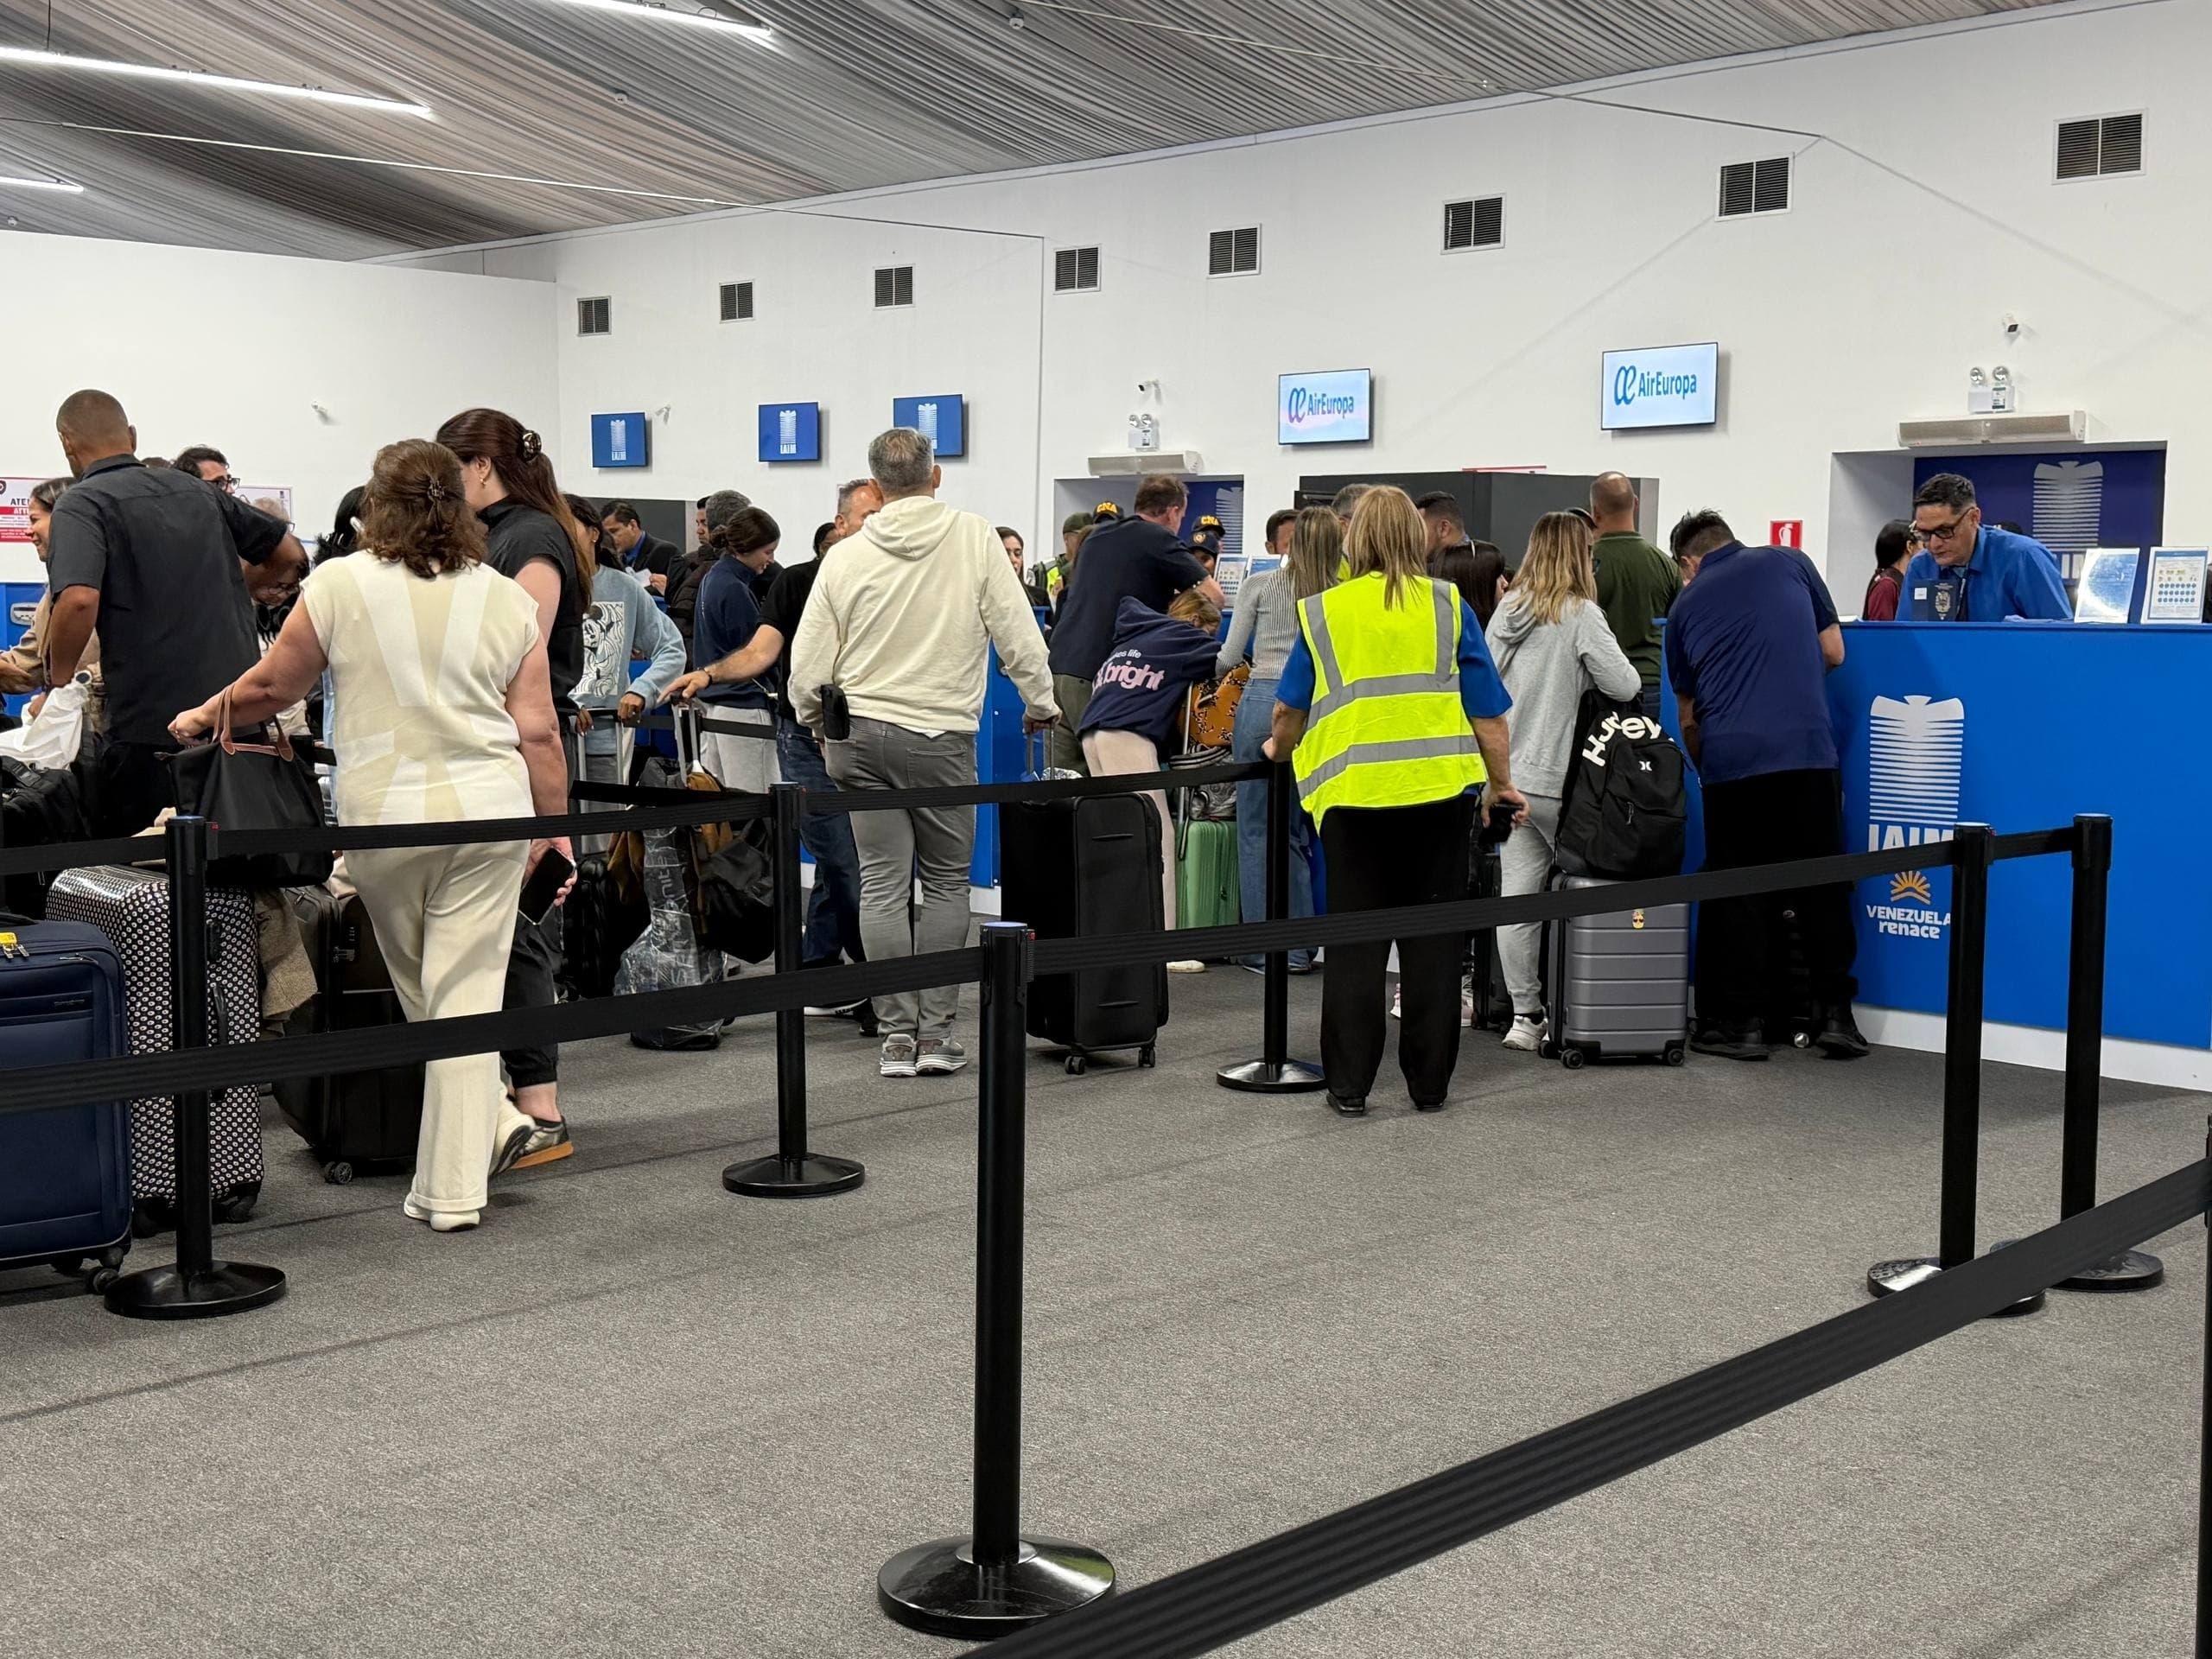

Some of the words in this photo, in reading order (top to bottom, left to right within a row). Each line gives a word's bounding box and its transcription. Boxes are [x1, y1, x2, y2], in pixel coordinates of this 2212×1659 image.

[1638, 371, 1698, 400] AirEuropa
[1307, 392, 1355, 419] AirEuropa
[1103, 660, 1165, 690] bright
[1581, 711, 1662, 767] Hurey
[1866, 905, 1951, 926] VENEZUELA
[1878, 921, 1941, 940] renace
